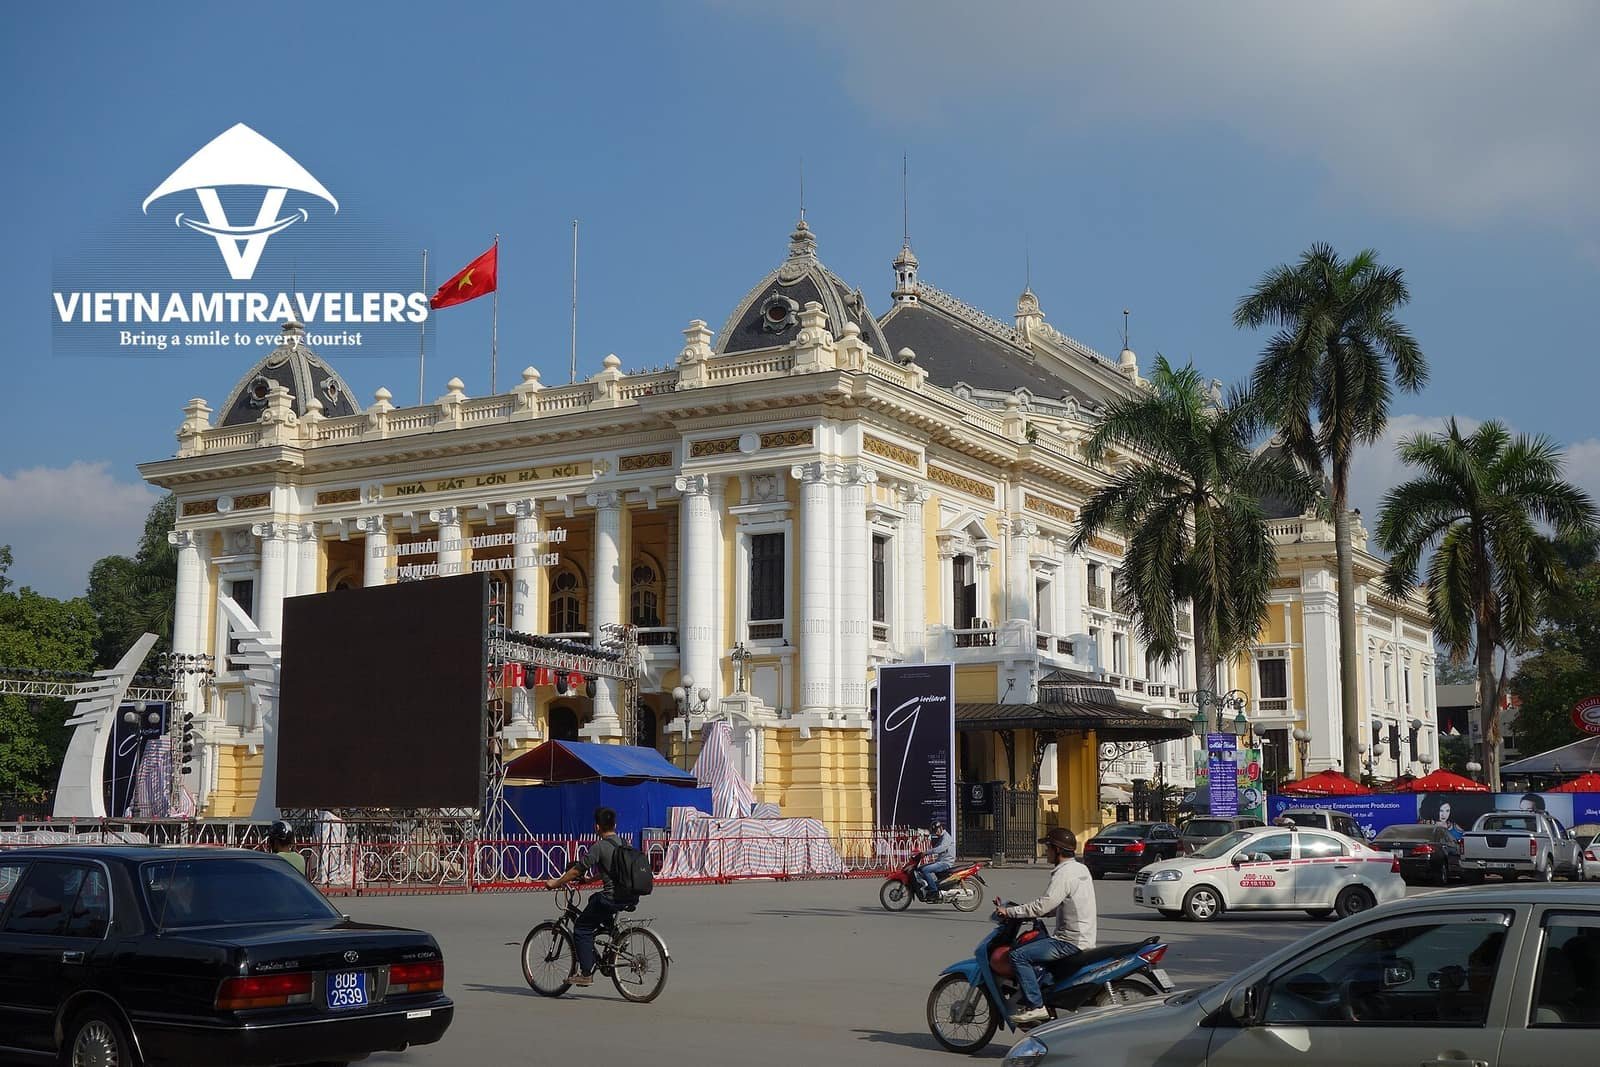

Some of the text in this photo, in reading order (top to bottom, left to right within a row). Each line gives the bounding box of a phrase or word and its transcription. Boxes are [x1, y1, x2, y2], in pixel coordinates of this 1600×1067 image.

[396, 481, 426, 496] NHÀ
[518, 468, 540, 481] HÀ
[335, 972, 357, 988] 80B
[331, 988, 362, 1005] 2539
